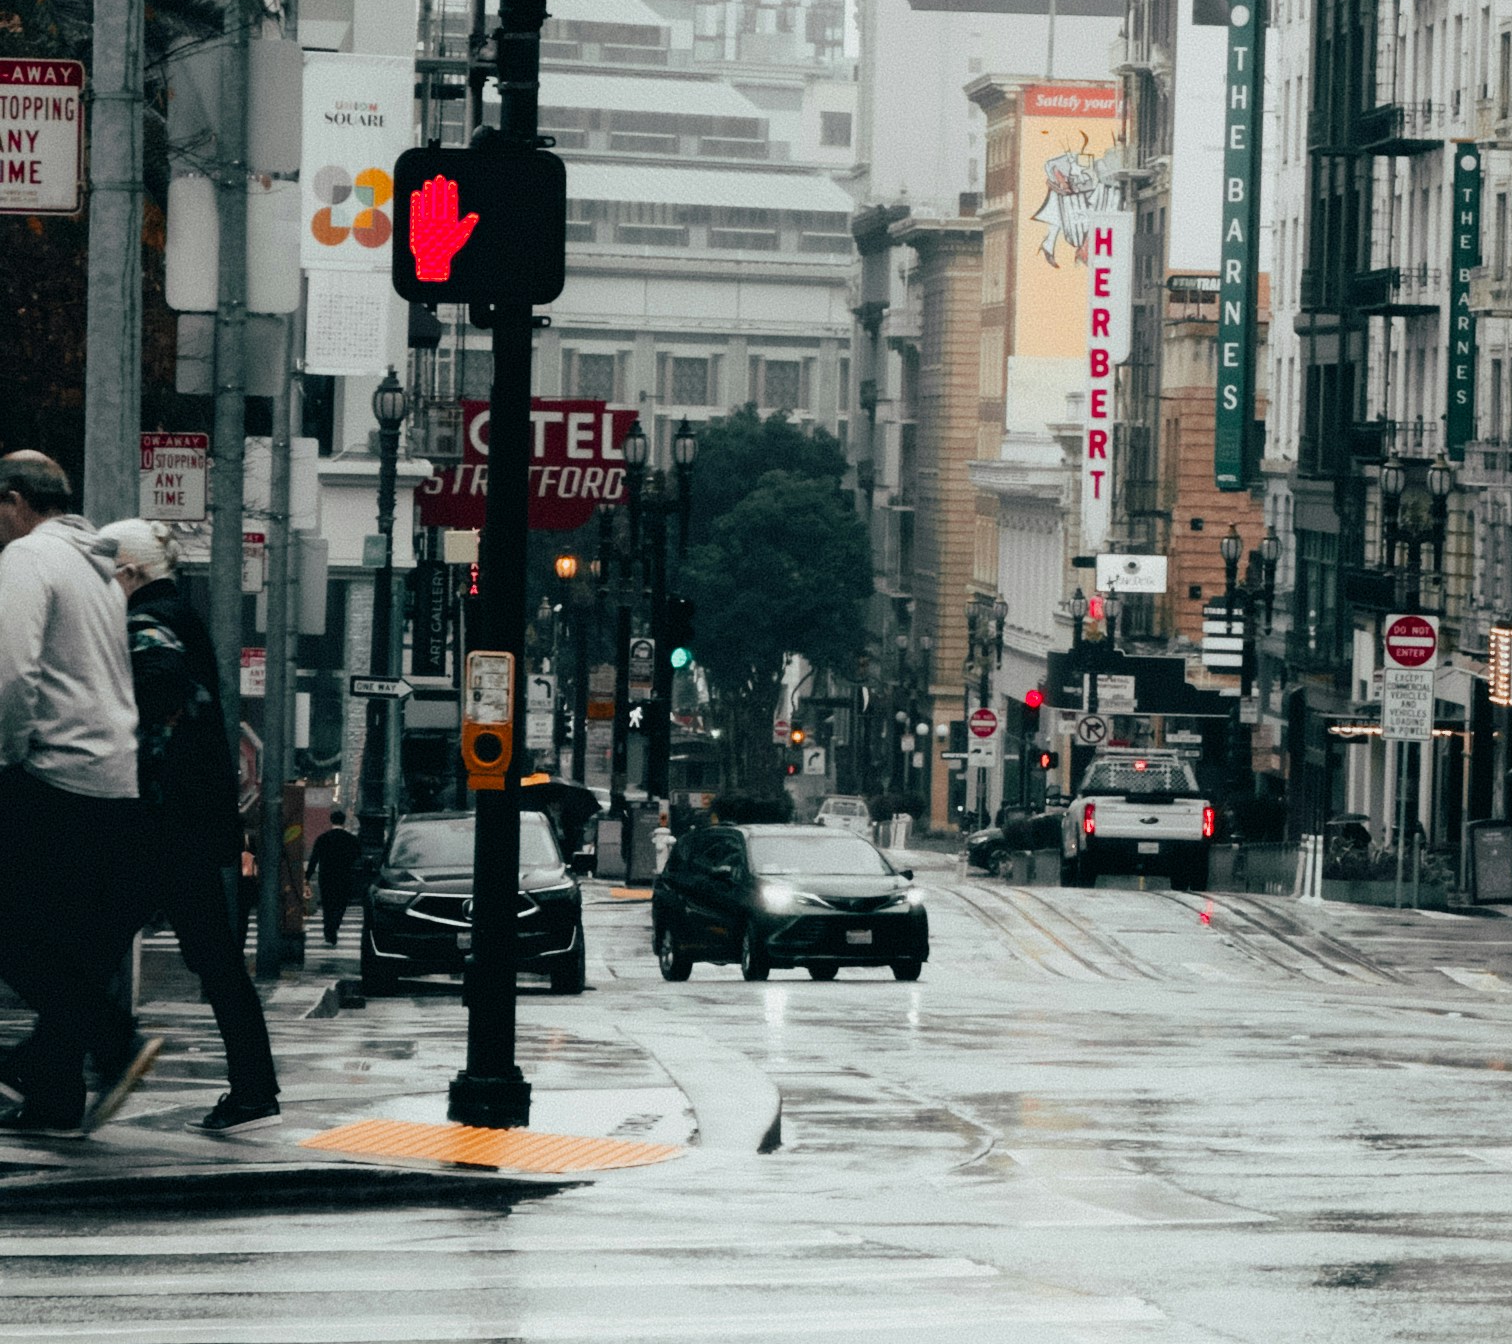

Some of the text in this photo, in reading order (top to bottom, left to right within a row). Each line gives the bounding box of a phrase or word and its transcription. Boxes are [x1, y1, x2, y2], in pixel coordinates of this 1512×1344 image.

[1035, 94, 1080, 112] Satisfy
[1082, 98, 1113, 112] your
[1229, 46, 1248, 150] THE
[324, 113, 384, 128] SQUARE
[0, 129, 39, 154] NY
[1223, 177, 1245, 410] BARNES
[1456, 188, 1473, 404] THE BARNES
[1088, 227, 1113, 500] HERBERT
[156, 454, 205, 469] STOPPING
[155, 473, 183, 488] ANY
[424, 462, 628, 500] STRTFORD
[153, 491, 185, 506] TIME
[430, 567, 444, 666] ART GALLERY
[1393, 626, 1430, 635] DO NOT
[1396, 648, 1425, 657] ENTER
[1394, 674, 1423, 683] EXCEPT
[356, 682, 397, 693] ONE WAY
[1387, 682, 1431, 691] COMMERCIAL
[1391, 691, 1426, 700] VEHICLES
[1401, 700, 1416, 708] AND
[1390, 708, 1426, 717] VEHICLES
[1390, 717, 1424, 726] LOADING
[1400, 727, 1428, 735] POWELL
